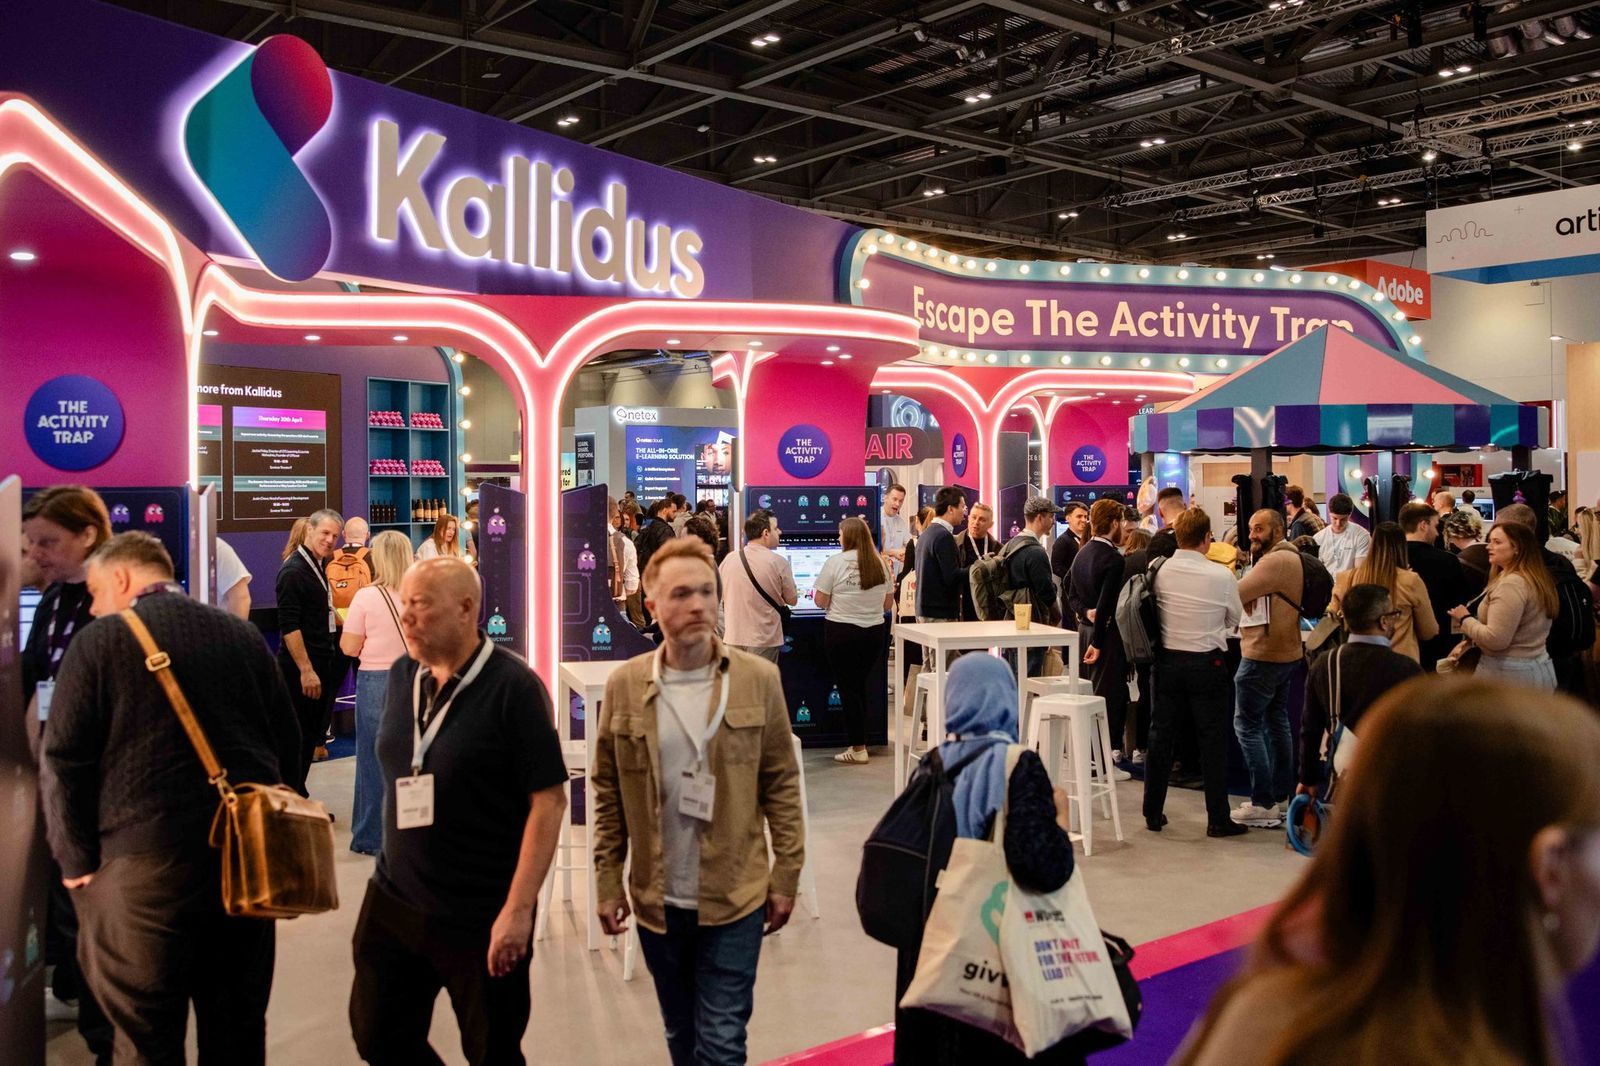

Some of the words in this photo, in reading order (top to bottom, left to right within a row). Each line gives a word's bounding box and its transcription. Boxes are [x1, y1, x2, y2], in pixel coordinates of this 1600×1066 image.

[371, 119, 705, 298] Kallidus
[1376, 276, 1424, 305] Adobe
[913, 285, 1015, 344] Escape
[1025, 299, 1099, 337] The
[1109, 301, 1260, 349] Activity
[221, 383, 243, 396] from
[245, 385, 283, 398] Kallidus
[57, 400, 88, 414] THE
[37, 414, 109, 429] ACTIVITY
[628, 411, 657, 421] netex
[53, 431, 95, 444] TRAP
[795, 438, 812, 447] THE
[785, 446, 824, 455] ACTIVITY
[865, 433, 913, 460] AIR
[793, 455, 815, 464] TRAP
